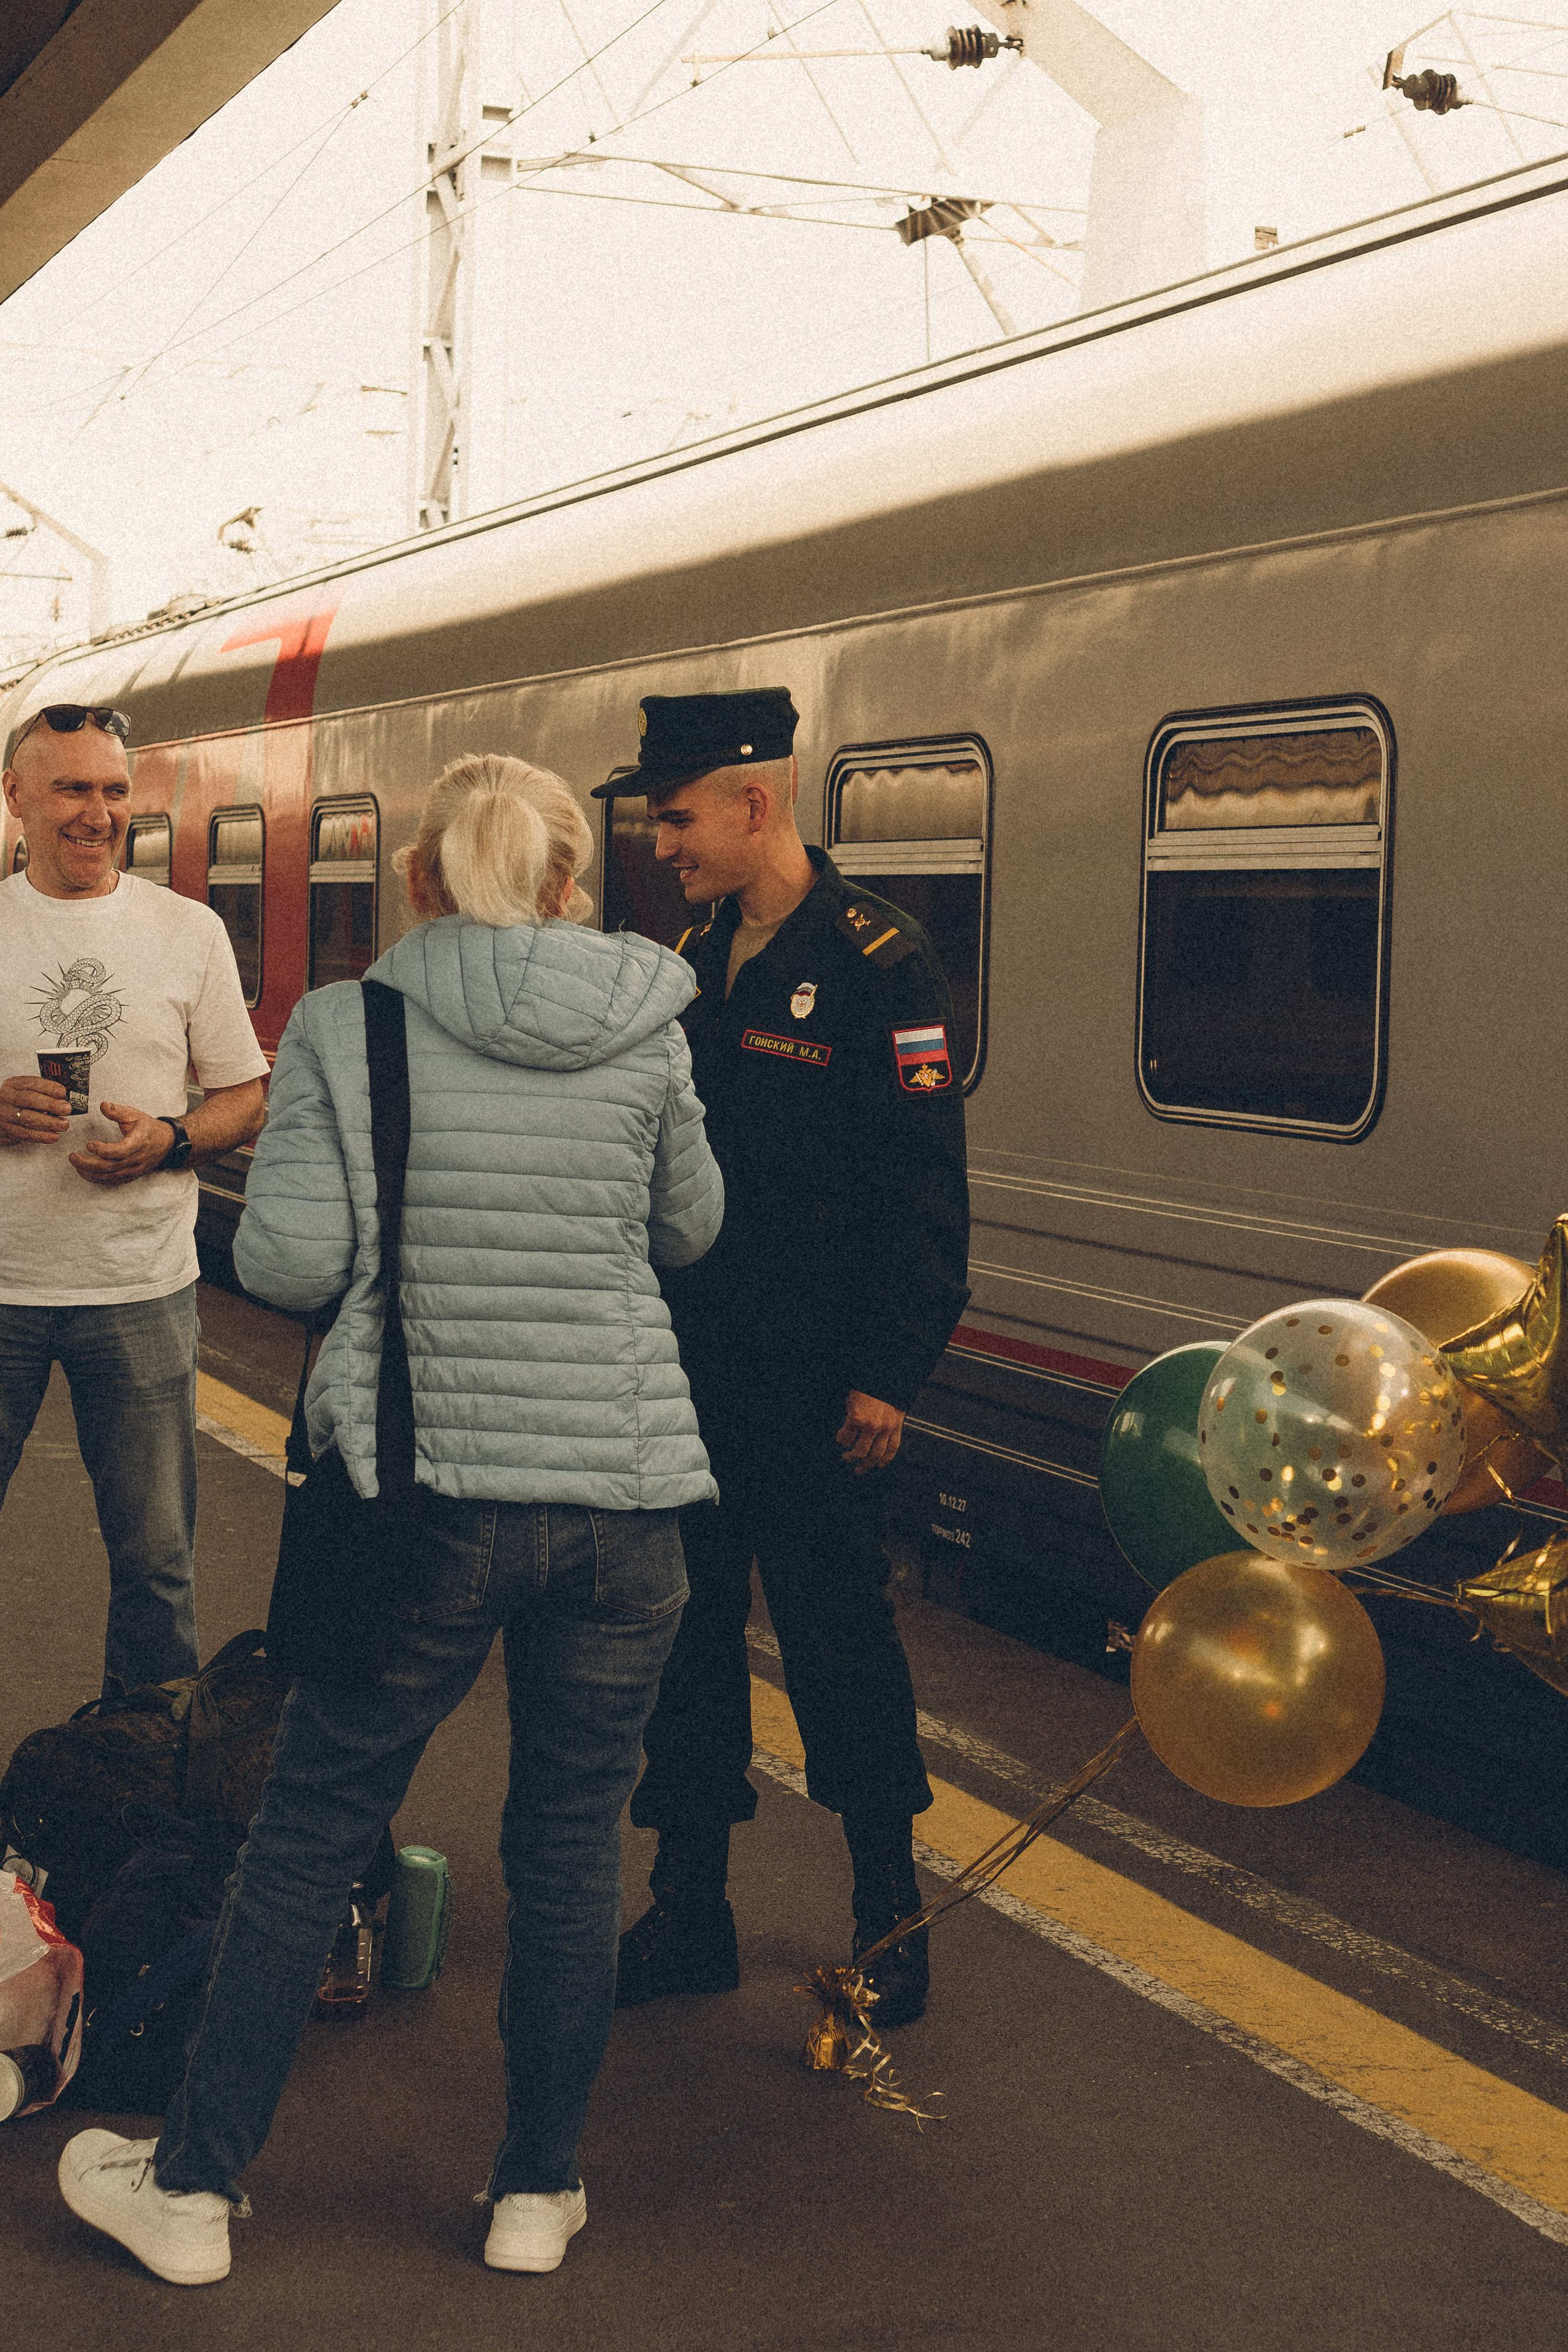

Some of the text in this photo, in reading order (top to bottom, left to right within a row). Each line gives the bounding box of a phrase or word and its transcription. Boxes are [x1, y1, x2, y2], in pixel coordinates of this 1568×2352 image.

[748, 1035, 821, 1060] ГОНСКИЙ М.А.
[939, 1492, 967, 1512] 10.12.27
[930, 1523, 971, 1548] ТОРМОЗ 242
